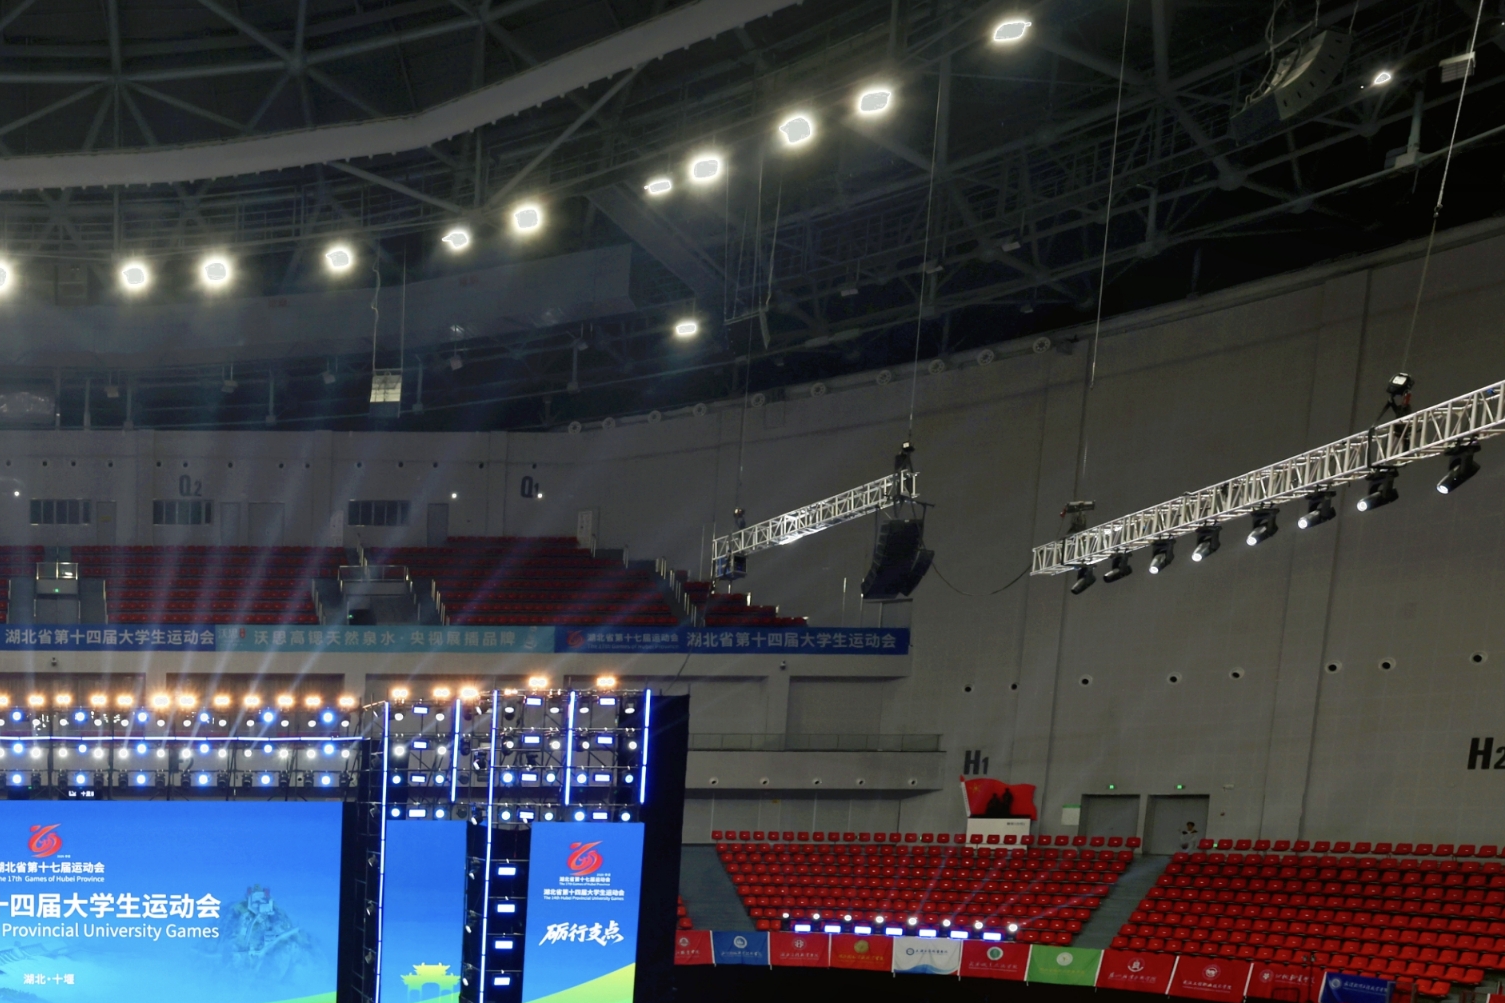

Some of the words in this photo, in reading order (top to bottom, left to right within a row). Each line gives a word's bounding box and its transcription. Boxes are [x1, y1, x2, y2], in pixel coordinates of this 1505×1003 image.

[179, 474, 202, 497] Q2
[5, 628, 214, 645] 湖北省第十四届大学生运动会
[587, 633, 679, 642] 湖北省第十七届运动会
[686, 631, 896, 648] 湖北省第十四届大学生运动会
[963, 750, 989, 775] H1
[1467, 737, 1505, 770] H2
[2, 922, 79, 938] Provincial
[83, 922, 162, 942] University
[166, 923, 220, 939] Games
[538, 920, 625, 947] 砺行支点
